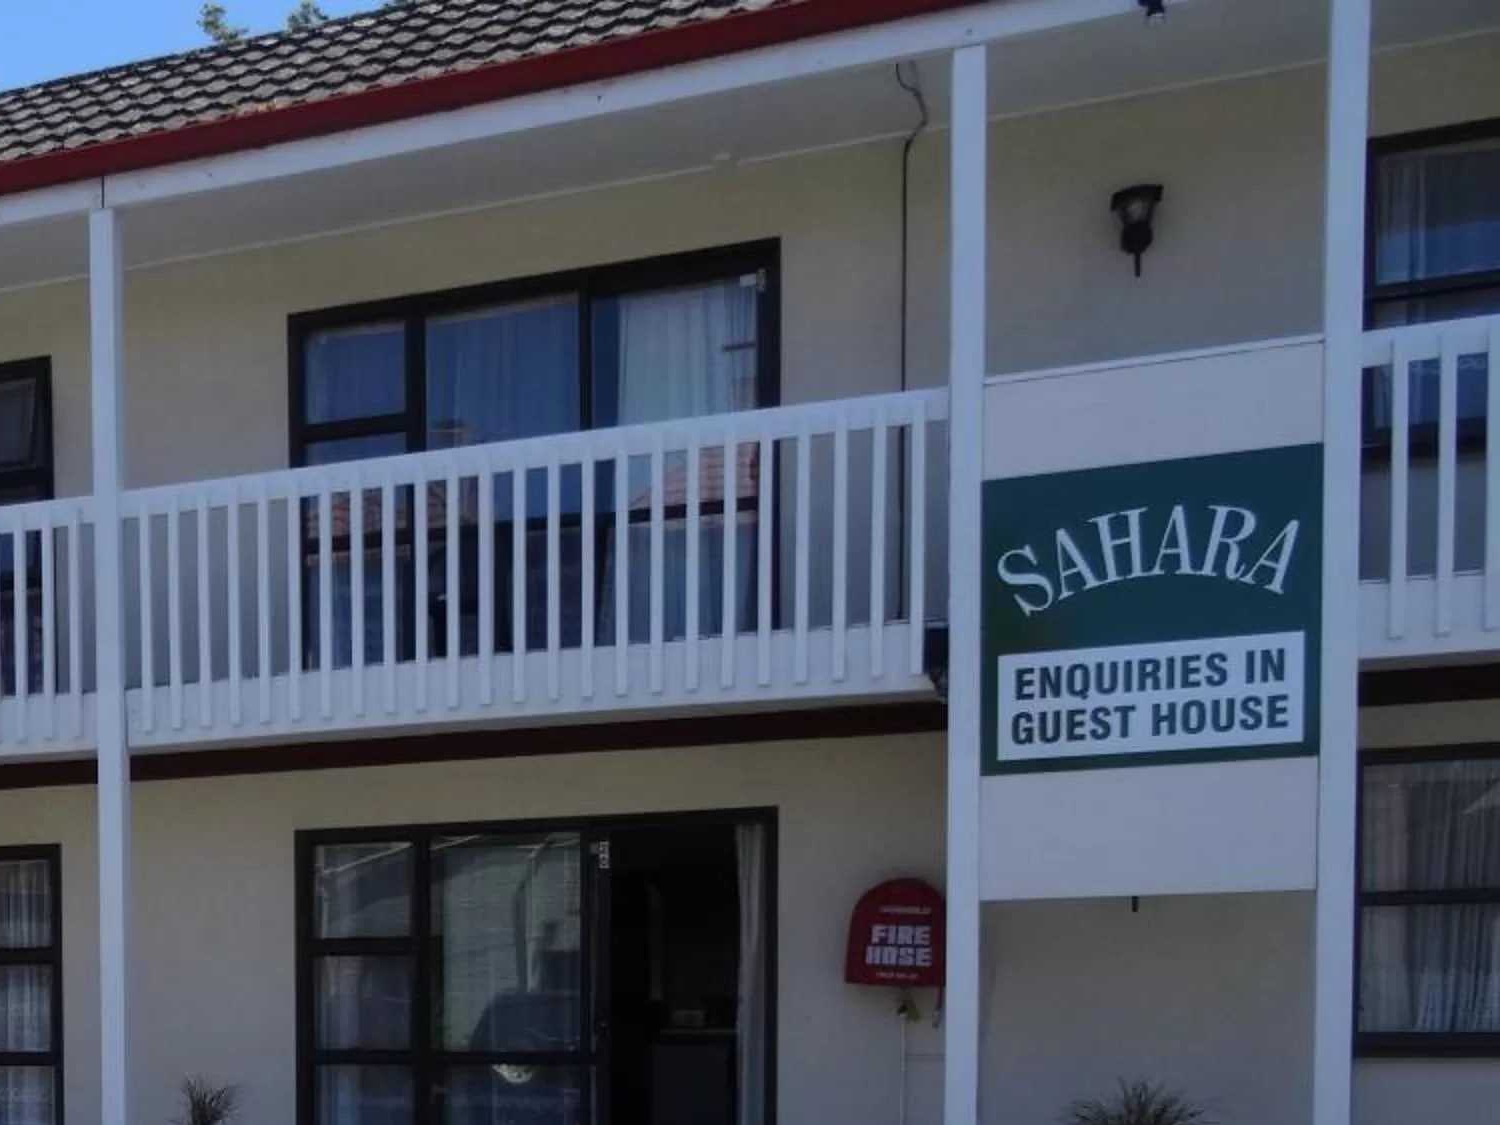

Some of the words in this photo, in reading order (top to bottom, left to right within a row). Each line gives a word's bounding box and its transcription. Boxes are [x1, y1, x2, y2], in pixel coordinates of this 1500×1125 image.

[998, 504, 1300, 617] SAHARA
[1014, 653, 1229, 701] ENQUIRIES
[1245, 648, 1286, 684] IN
[1011, 706, 1137, 744] GUEST
[1151, 694, 1290, 736] HOUSE
[865, 945, 933, 967] HOSE
[871, 924, 932, 945] FIRE
